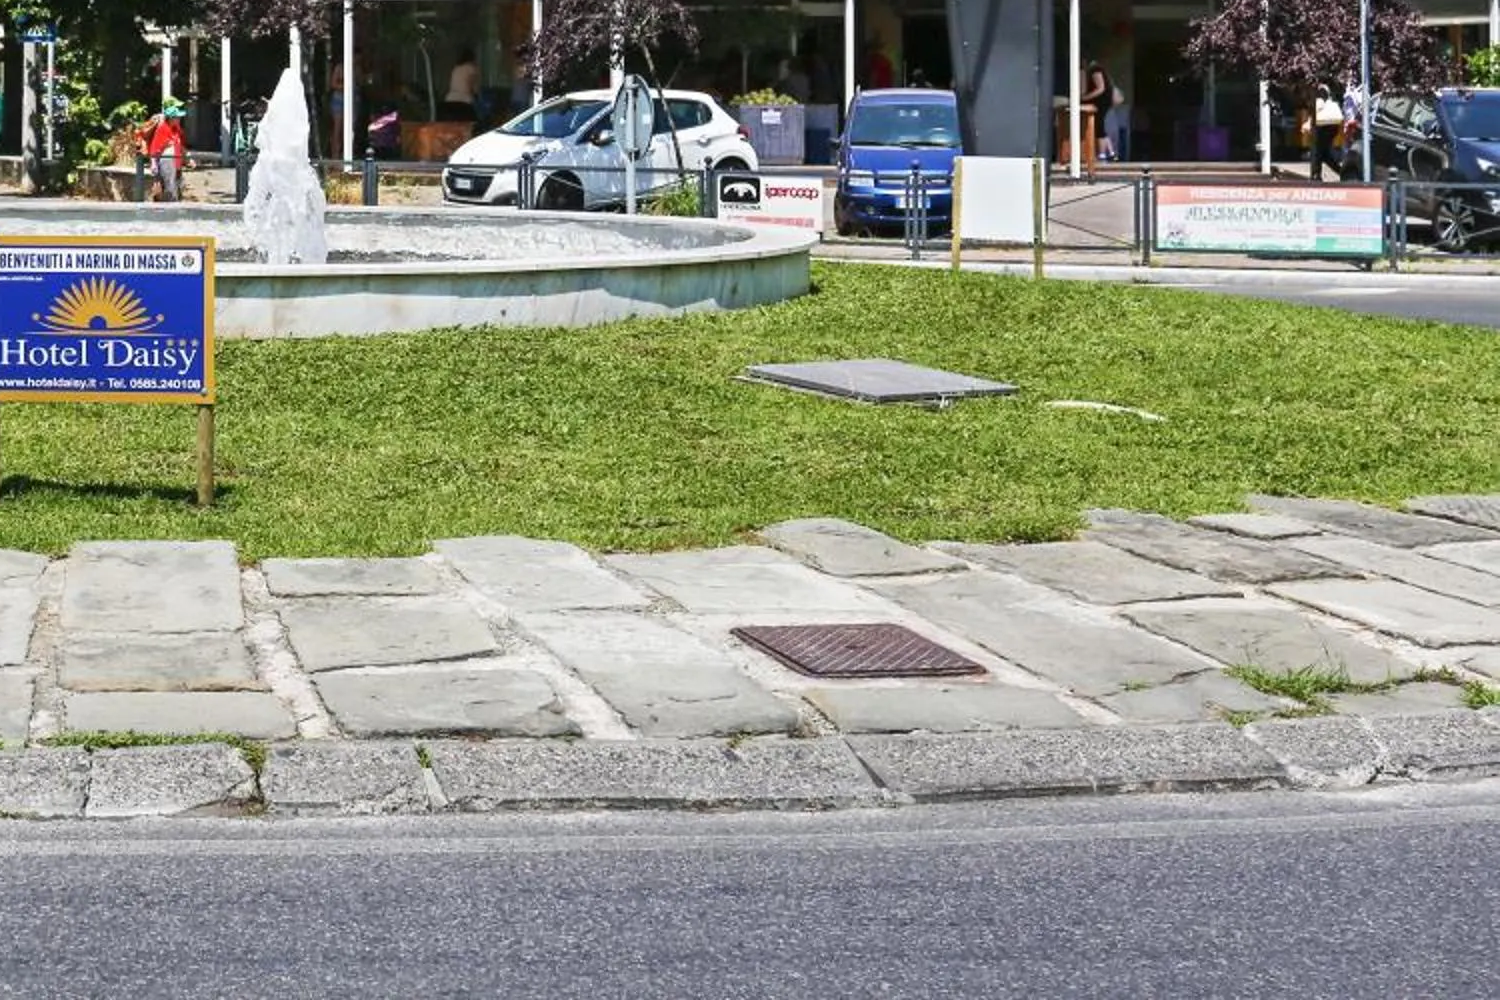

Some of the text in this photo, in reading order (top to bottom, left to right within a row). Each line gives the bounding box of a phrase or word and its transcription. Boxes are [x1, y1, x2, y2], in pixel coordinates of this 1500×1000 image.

[764, 183, 819, 200] ipercoop
[0, 253, 177, 270] BENVENUTI A MARINA DI MASSA
[97, 339, 197, 375] Daisy
[107, 377, 127, 389] Tel.
